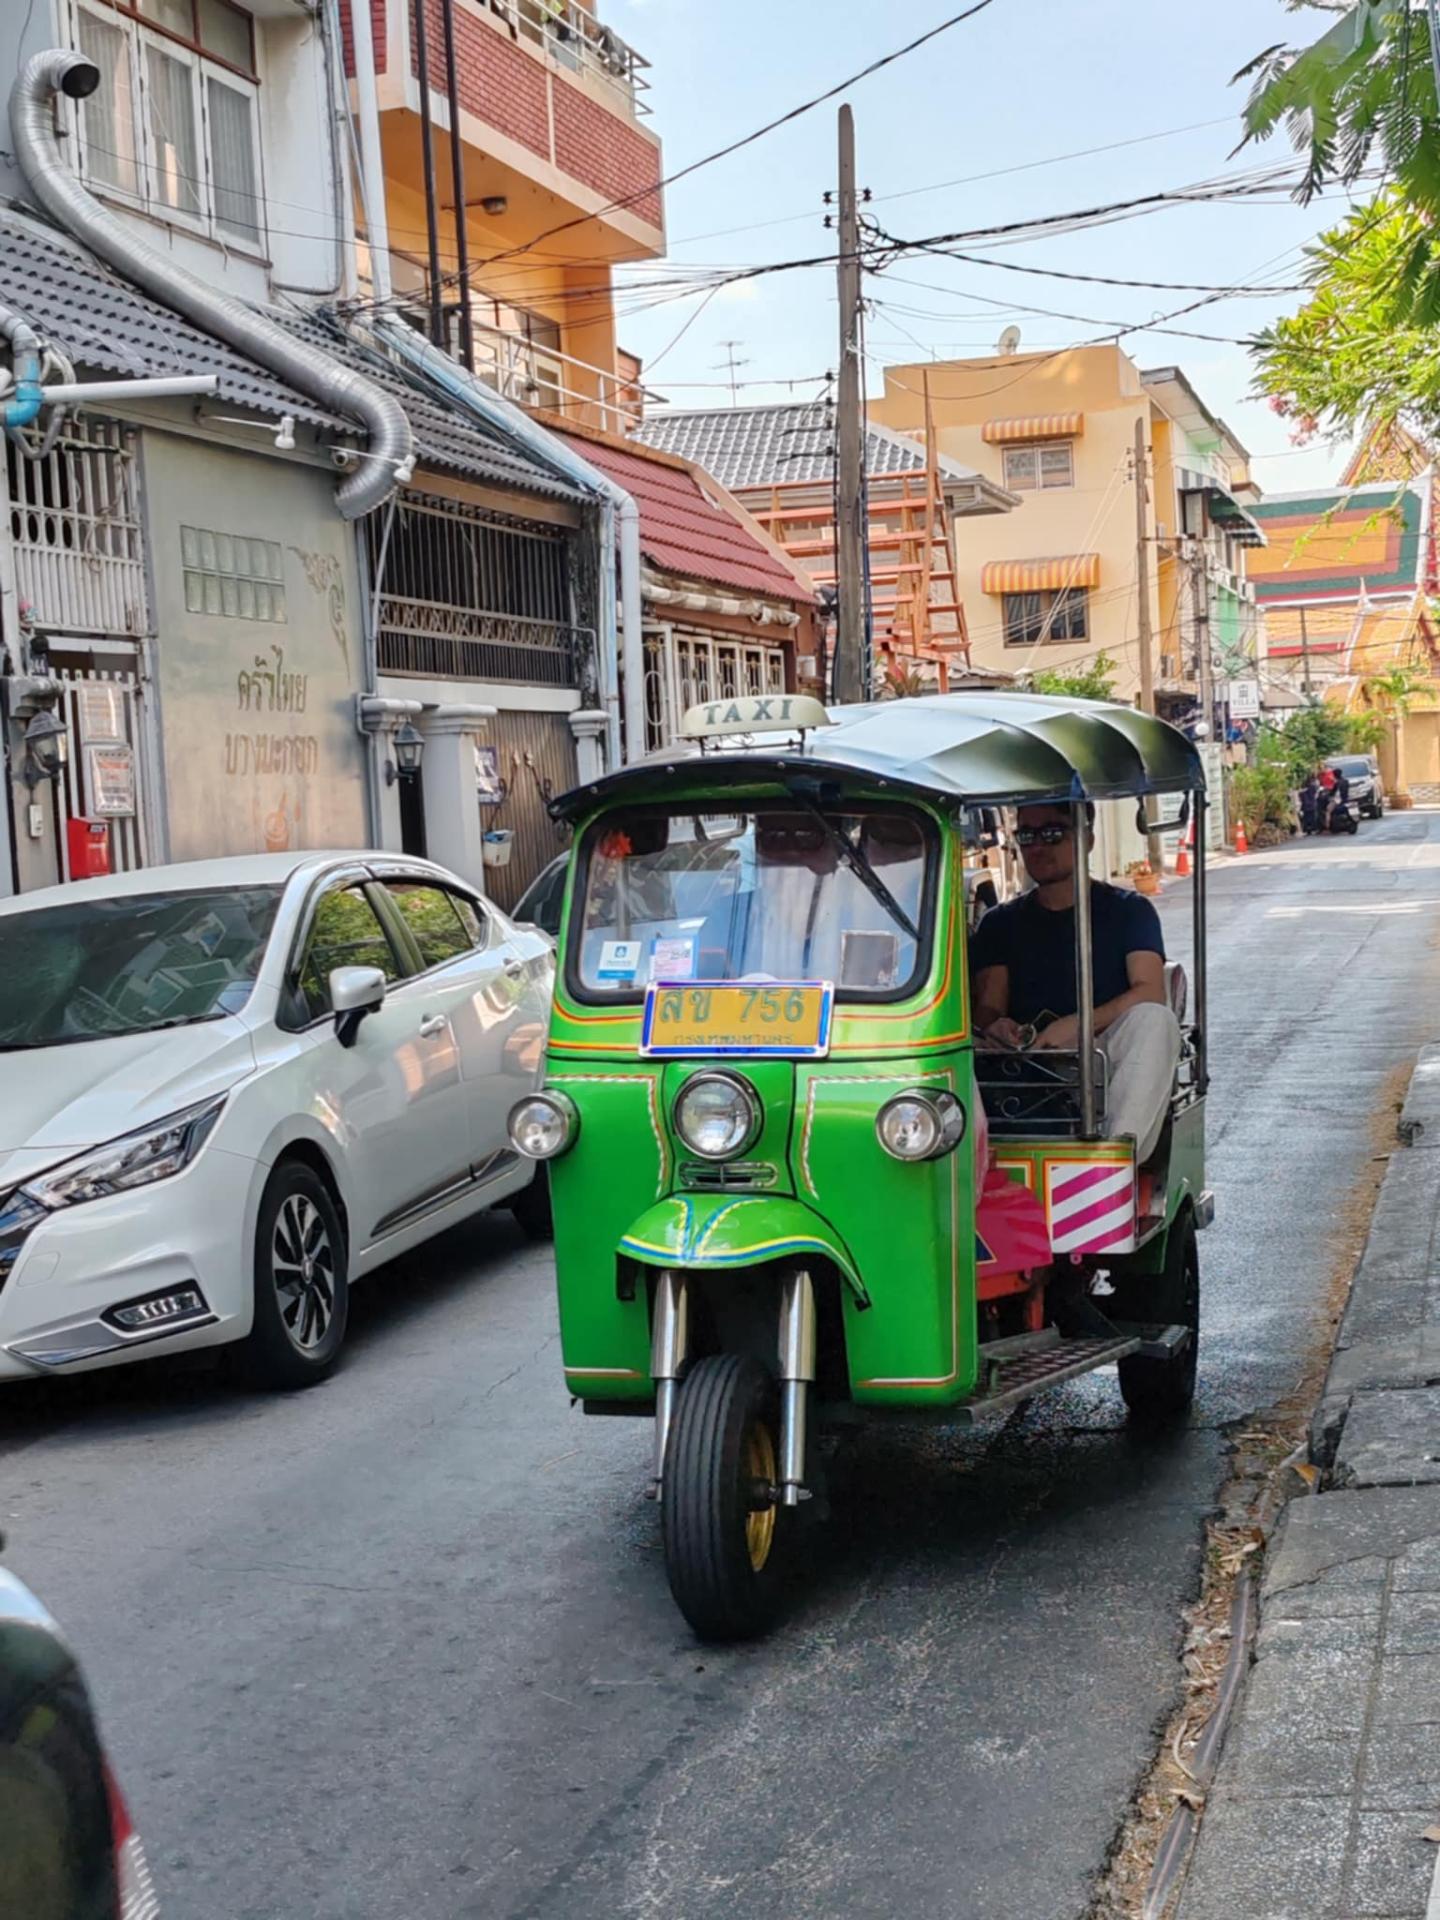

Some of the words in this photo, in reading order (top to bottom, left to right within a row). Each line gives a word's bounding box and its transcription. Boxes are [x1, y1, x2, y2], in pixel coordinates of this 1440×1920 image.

[238, 644, 307, 713] ครัวไทย
[703, 699, 793, 725] TAXI
[738, 988, 805, 1023] 756
